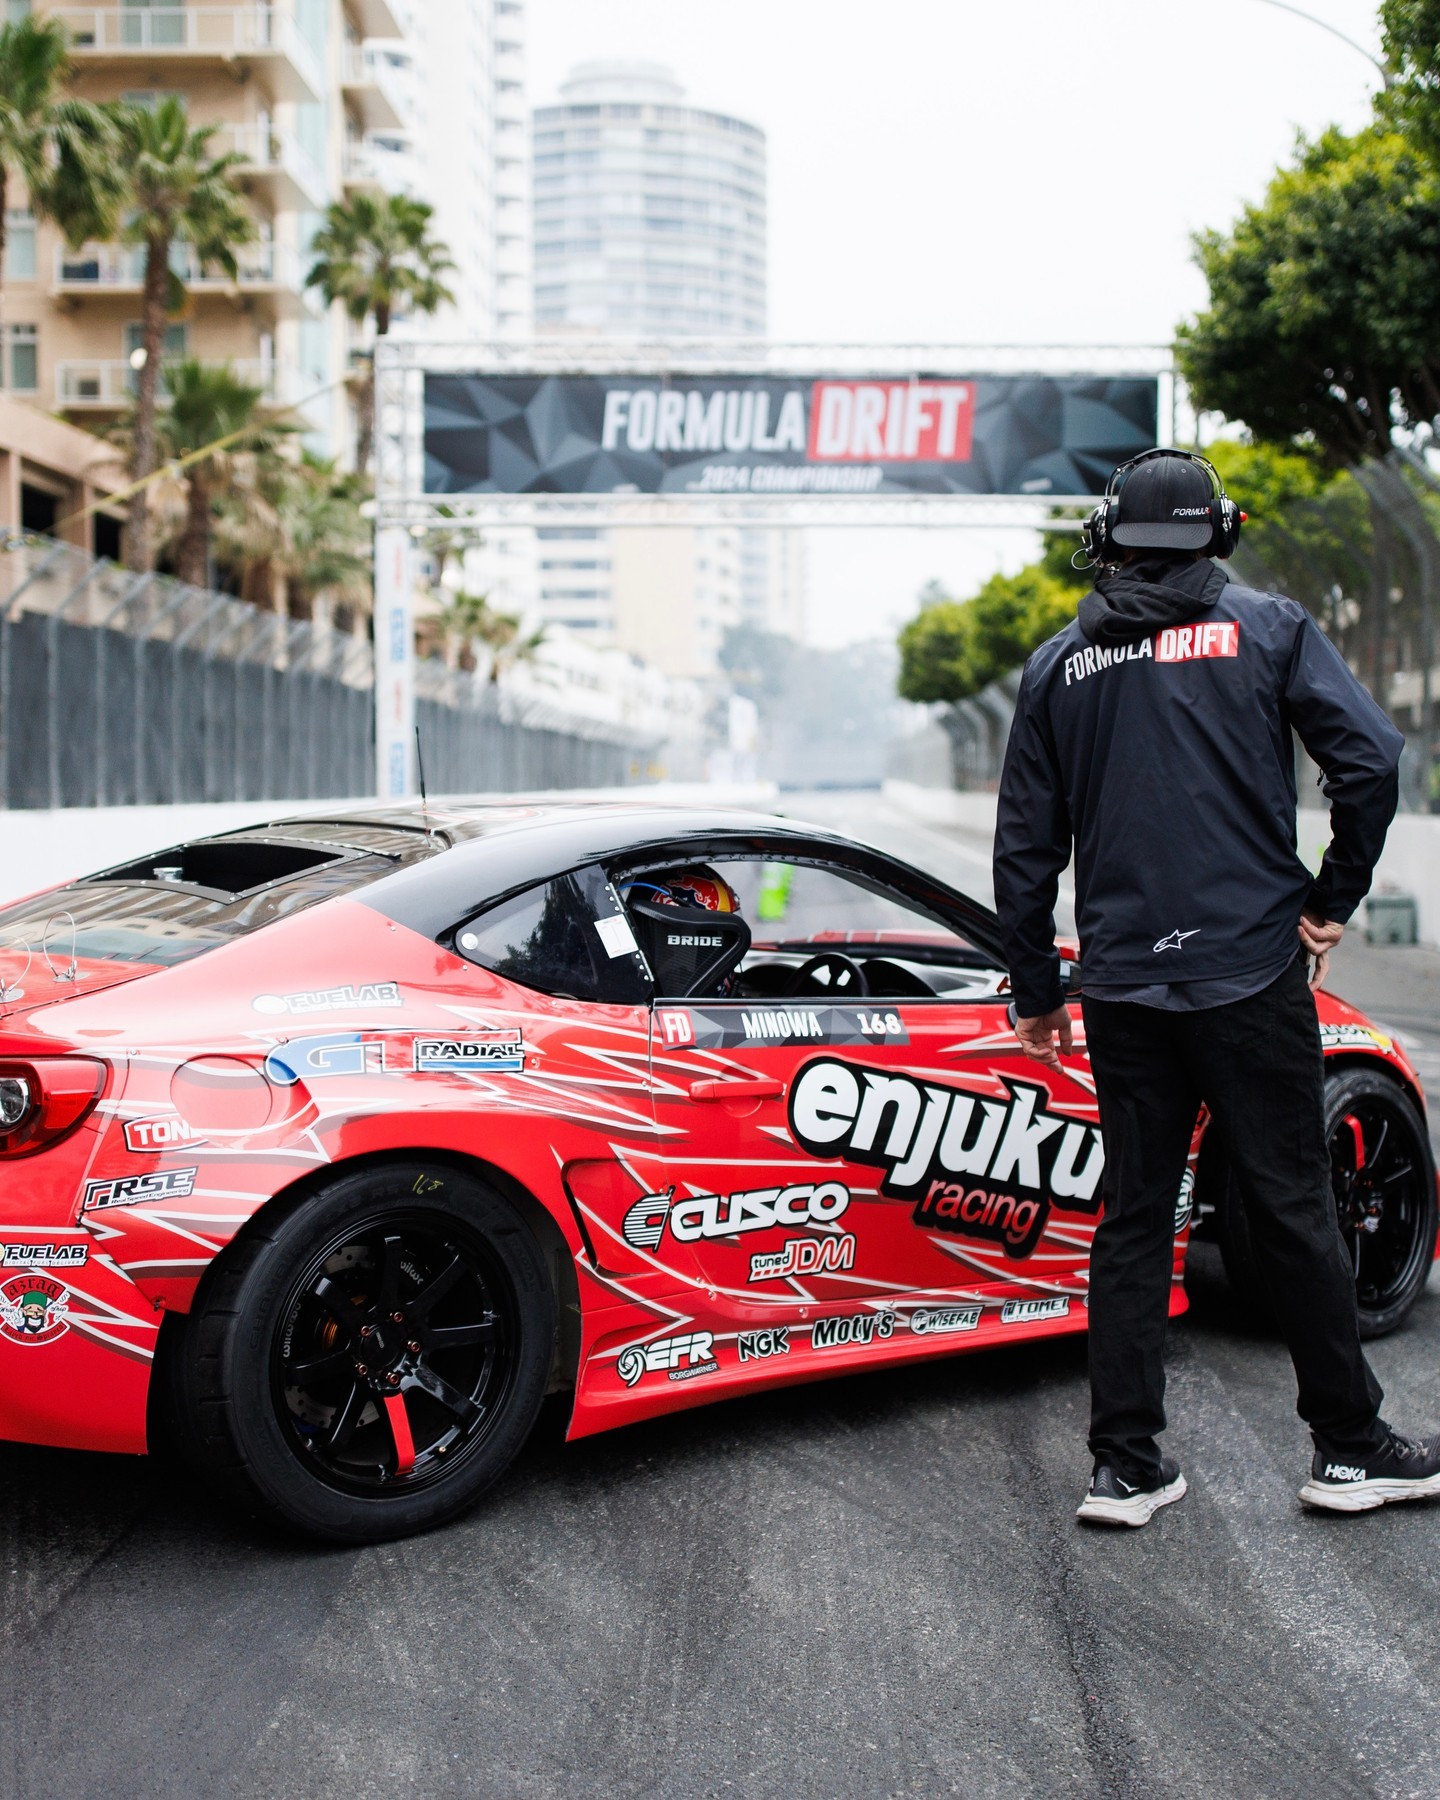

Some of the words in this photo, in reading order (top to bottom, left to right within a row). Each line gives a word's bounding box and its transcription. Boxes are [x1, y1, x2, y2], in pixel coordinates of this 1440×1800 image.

[602, 389, 807, 453] FORMULA
[815, 382, 968, 459] DRIFT
[702, 466, 749, 491] 2024
[1160, 624, 1235, 661] DRIFT
[667, 935, 722, 946] BRIDE
[287, 986, 396, 1008] FUELAB
[662, 1012, 692, 1043] FD
[741, 1012, 823, 1038] MINOWA
[857, 1013, 901, 1035] 168
[420, 1043, 524, 1059] RADIAL
[134, 1119, 200, 1145] TON
[793, 1063, 1105, 1200] enjuku
[671, 1184, 849, 1241] CUSCO
[921, 1179, 1040, 1242] racing
[6, 1246, 85, 1259] FUELAB
[753, 1251, 790, 1269] tuned
[785, 1238, 853, 1273] JDM
[928, 1312, 979, 1327] WISEFAB
[1018, 1297, 1068, 1315] TOMEI
[813, 1313, 894, 1347] Moty's
[646, 1332, 715, 1371] EFR
[738, 1328, 789, 1361] NGK
[669, 1362, 717, 1380] BORGWARNER
[1324, 1463, 1366, 1481] HOKA
